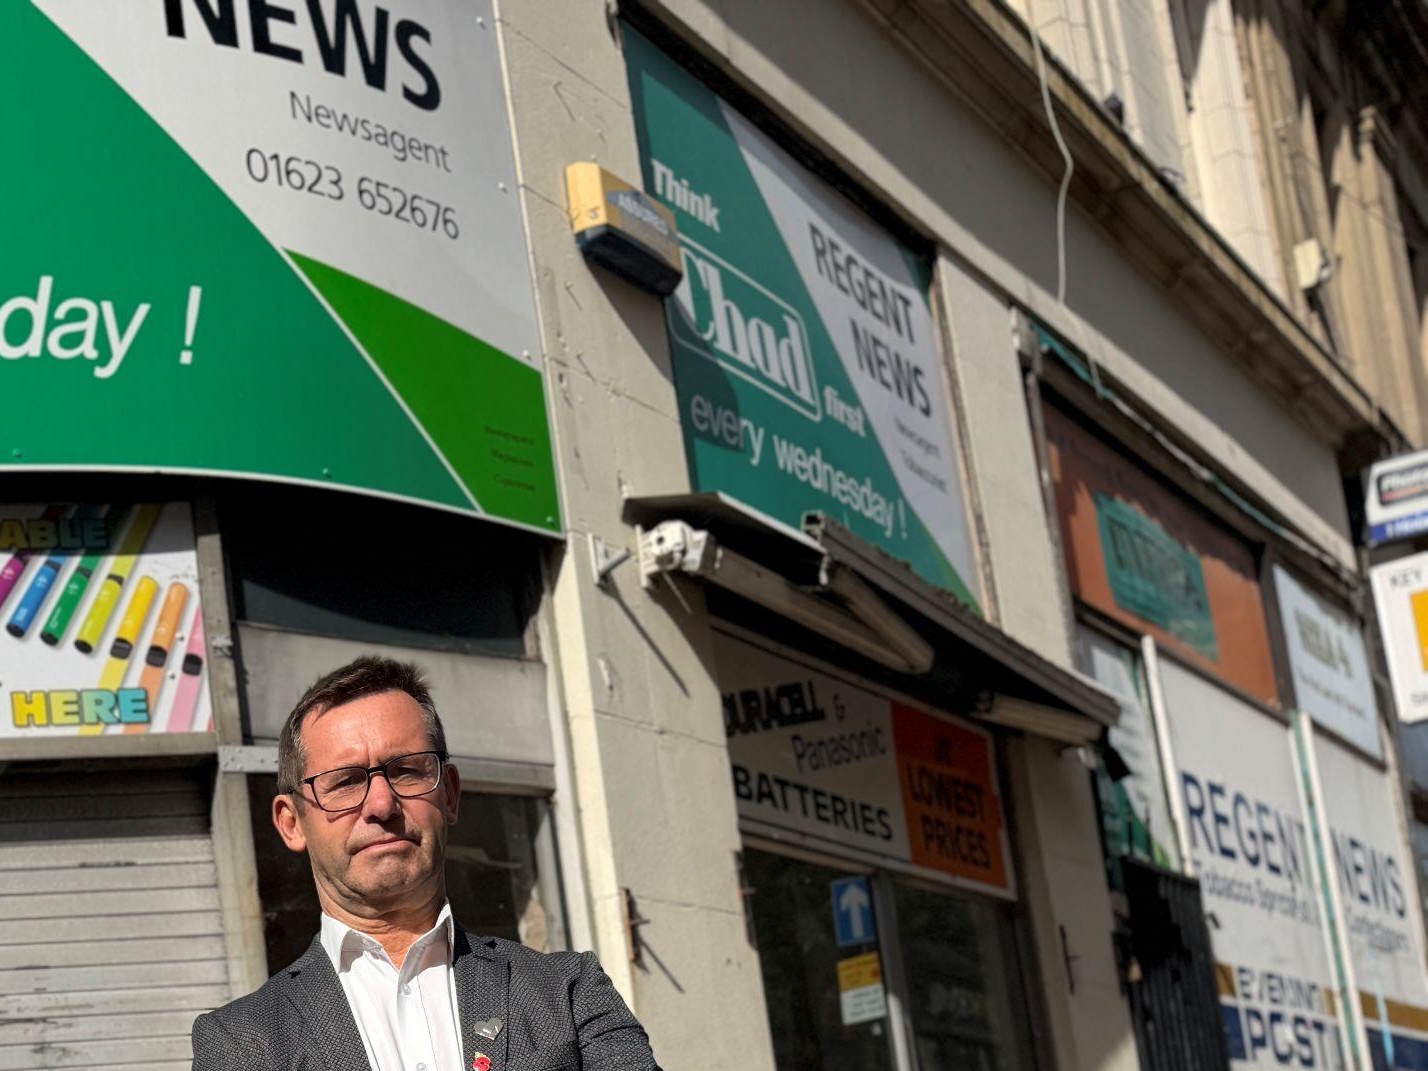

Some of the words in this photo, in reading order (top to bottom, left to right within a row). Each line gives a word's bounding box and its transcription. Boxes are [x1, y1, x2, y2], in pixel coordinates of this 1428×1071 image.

[288, 90, 452, 173] Newsagent
[245, 147, 345, 202] 01623
[357, 176, 461, 241] 652676
[650, 157, 721, 233] Think
[808, 221, 916, 346] REGENT
[674, 246, 816, 407] Chad
[849, 316, 932, 418] NEWS
[823, 384, 866, 438] first
[690, 394, 765, 467] every
[773, 433, 895, 540] wednesday
[10, 686, 152, 729] HERE
[791, 720, 889, 776] Panasonic
[731, 763, 895, 842] BATTERIES
[908, 761, 992, 826] LOWEST
[919, 811, 993, 871] PRICES
